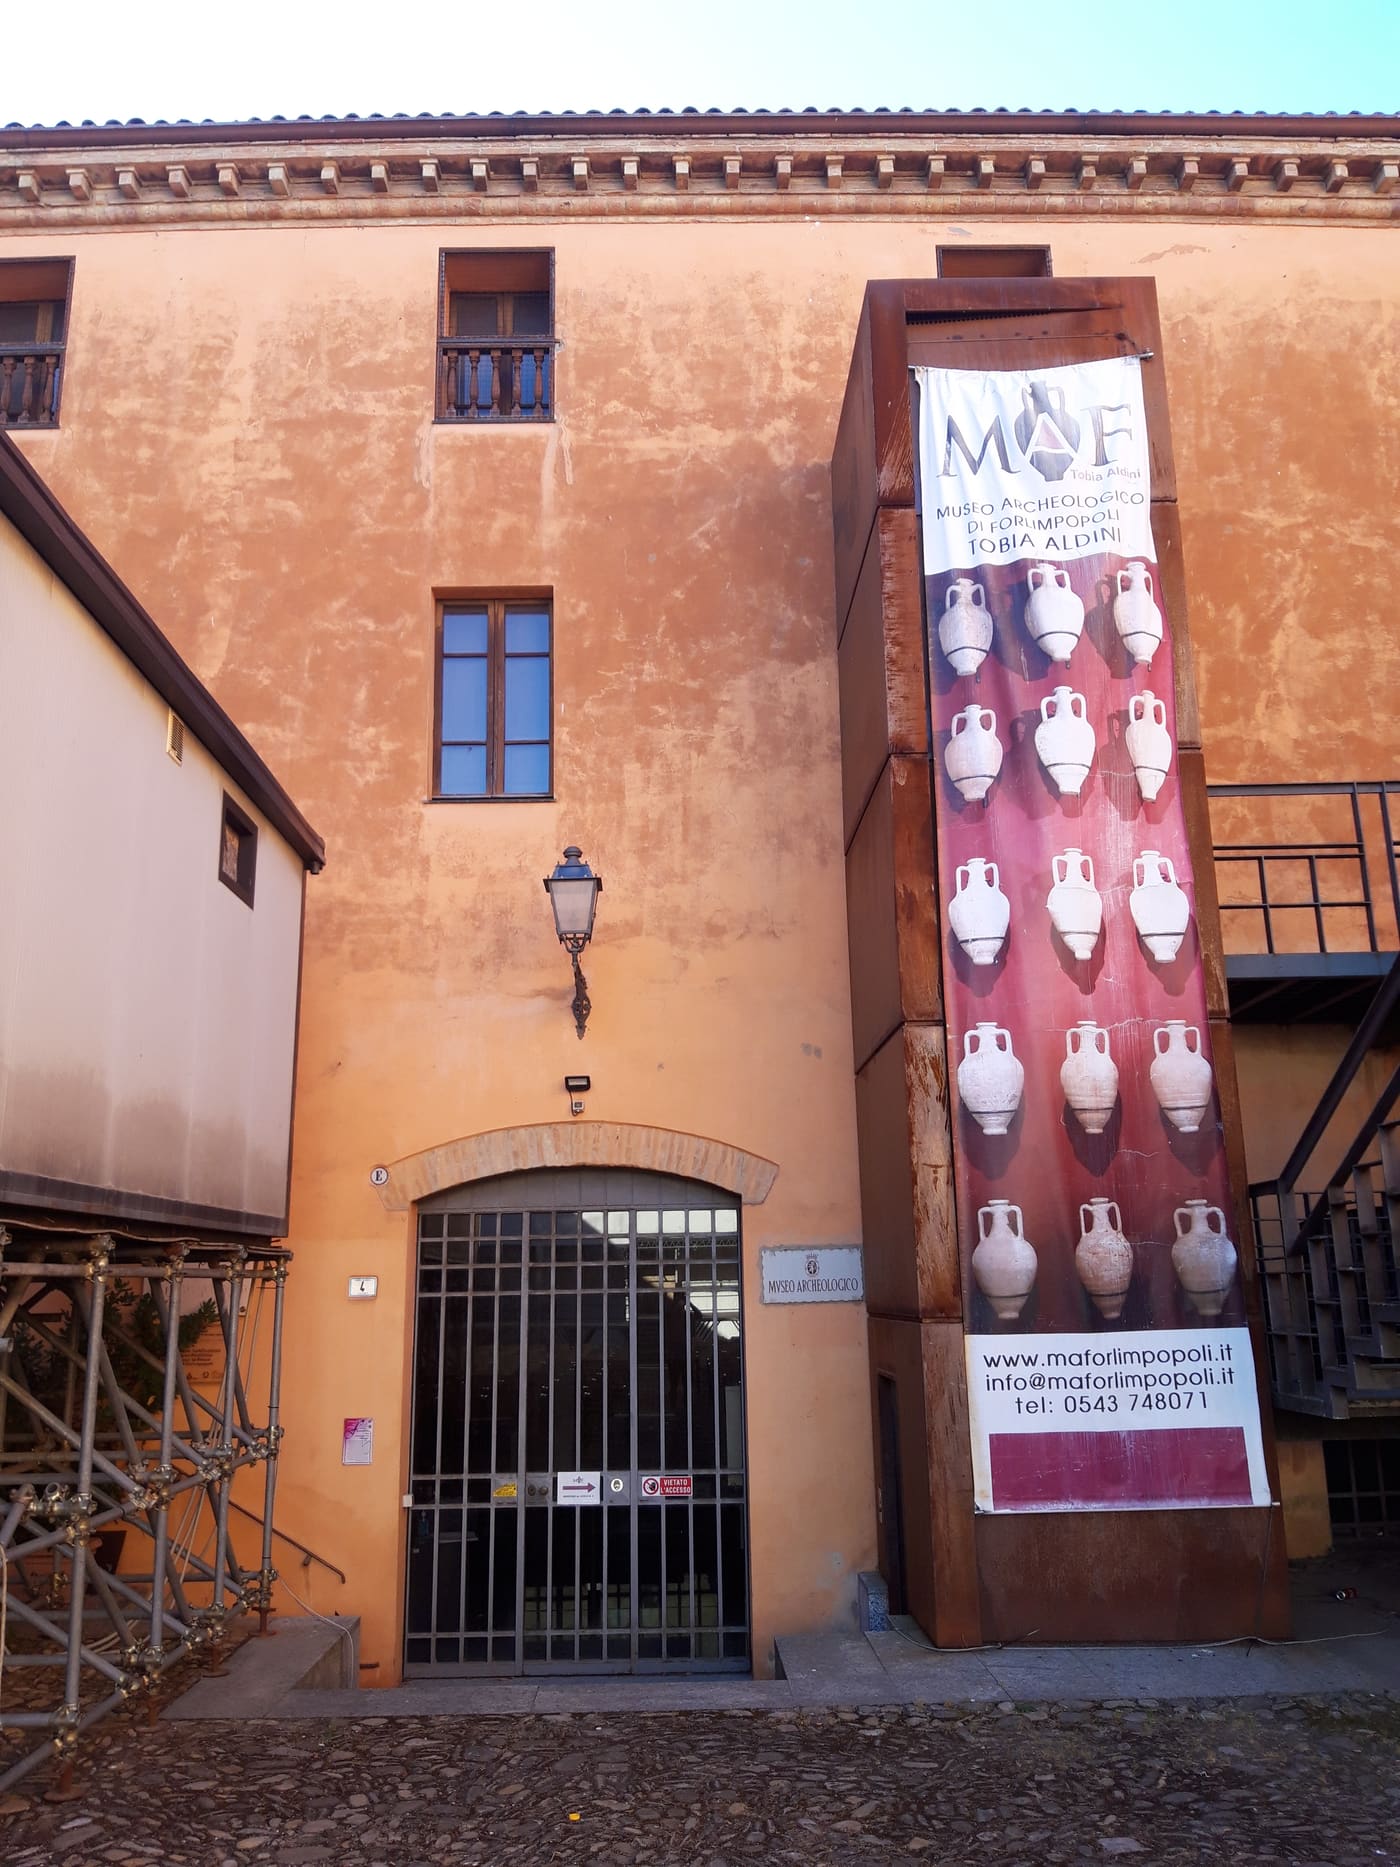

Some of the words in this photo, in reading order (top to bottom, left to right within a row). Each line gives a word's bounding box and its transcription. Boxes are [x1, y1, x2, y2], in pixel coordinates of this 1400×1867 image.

[1070, 468, 1103, 482] Tobia
[1106, 466, 1141, 479] Aldini
[937, 503, 994, 520] MUSEO
[1001, 491, 1144, 512] ARCHEOLOGICO
[968, 520, 984, 534] DI
[990, 510, 1120, 533] FORLIMPOPOLI
[968, 533, 1035, 555] TOBIA
[1045, 527, 1121, 551] ALDINI
[376, 1170, 383, 1182] E
[797, 1278, 859, 1292] ARCHEOLOGICO
[983, 1344, 1233, 1368] www.maforlimpopoli.it
[986, 1368, 1235, 1391] info@maforlimpopoli.it
[1015, 1396, 1053, 1414] tel:
[1064, 1395, 1119, 1413] 0543
[1129, 1391, 1208, 1411] 748071
[660, 1486, 691, 1494] L'ACCESSO
